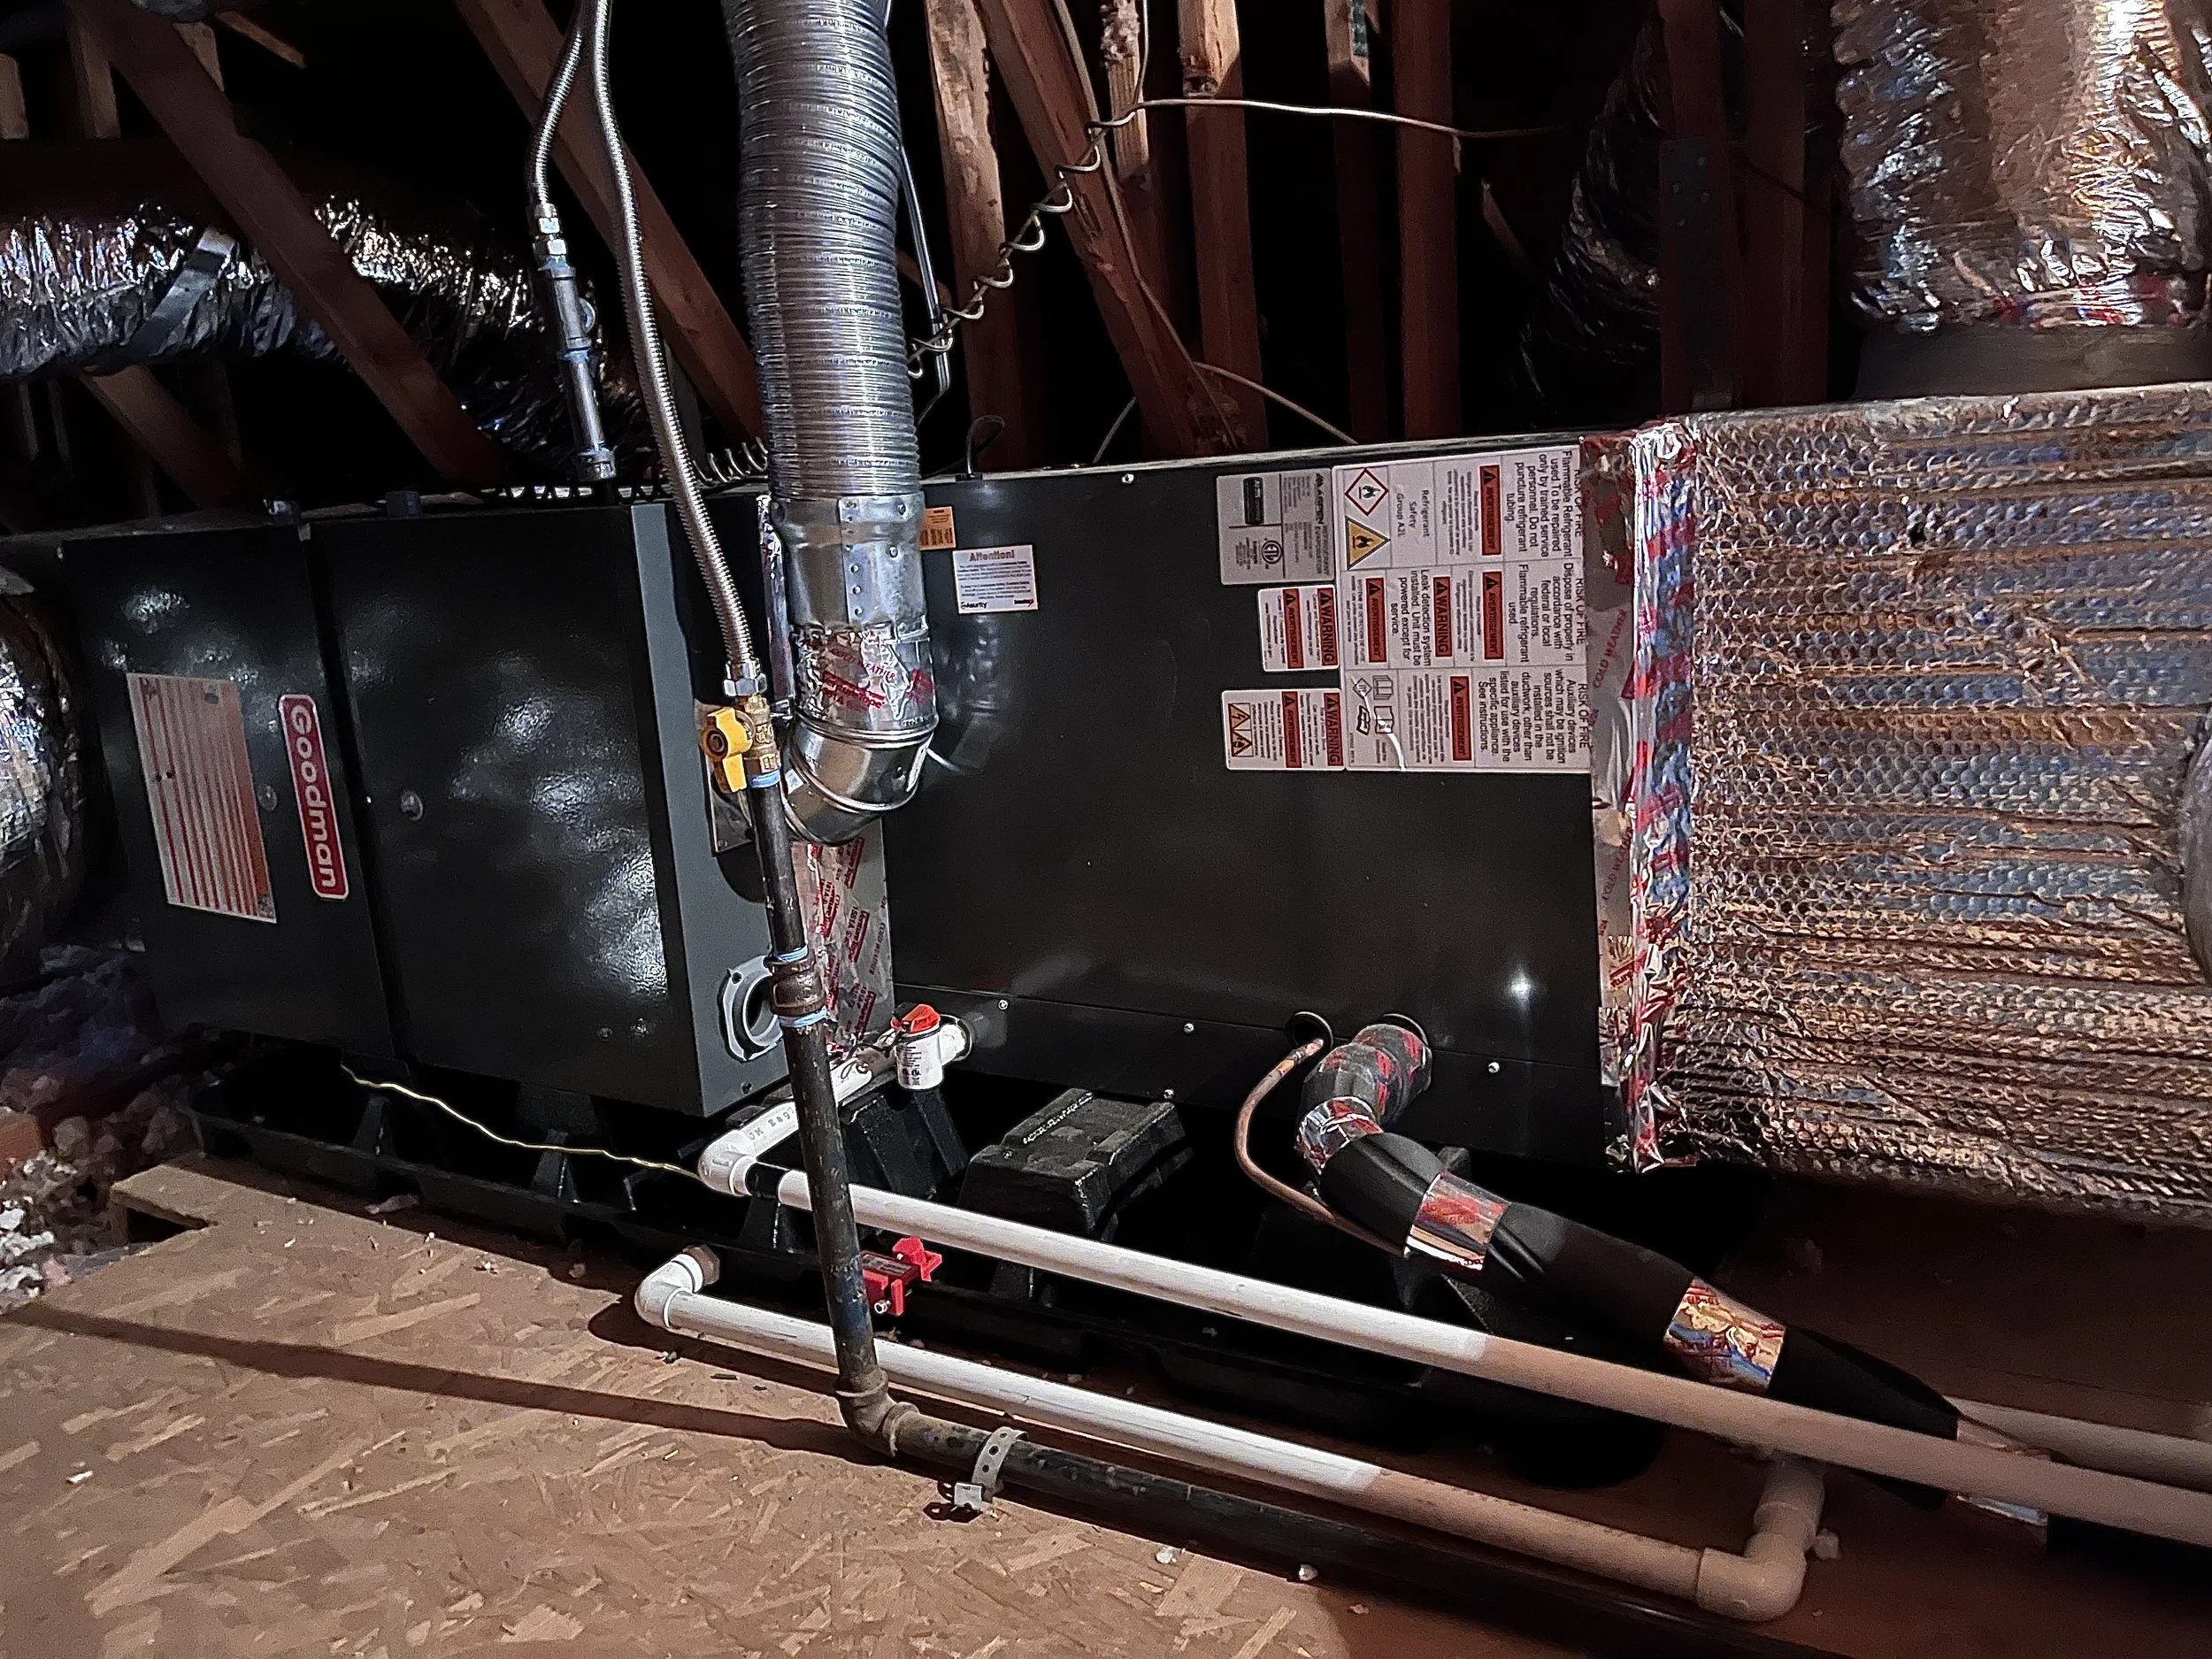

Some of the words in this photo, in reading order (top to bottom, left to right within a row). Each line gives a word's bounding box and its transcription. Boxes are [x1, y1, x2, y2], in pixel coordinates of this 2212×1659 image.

[1537, 454, 1548, 472] only
[1563, 450, 1571, 502] Flammable
[1515, 462, 1526, 502] puncture
[1539, 476, 1548, 488] by
[1552, 485, 1561, 496] To
[1396, 493, 1405, 520] Group
[1421, 489, 1430, 538] Refrigerant
[1540, 490, 1549, 521] trained
[1552, 499, 1561, 511] be
[1516, 505, 1527, 552] refrigerant
[1530, 517, 1539, 530] Do
[1550, 513, 1562, 551] repaired
[1561, 505, 1572, 557] Refrigerant
[1530, 533, 1539, 548] not
[970, 550, 1015, 562] Attention!
[1420, 570, 1431, 590] Leak
[1518, 565, 1529, 614] Flammable
[1563, 563, 1573, 600] Dispose
[1575, 579, 1584, 602] RISK
[1398, 577, 1409, 614] powered
[1541, 580, 1550, 611] federal
[1564, 603, 1574, 611] of
[1390, 603, 1400, 636] service.
[1421, 593, 1431, 633] detection
[1436, 595, 1448, 653] WARNING
[1488, 592, 1498, 654] AVERTISSEMENT
[1528, 588, 1540, 639] regulations.
[1542, 614, 1549, 623] or
[1576, 605, 1585, 618] OF
[1321, 606, 1335, 663] WARNING
[1371, 598, 1380, 657] AVERTISSEMENT
[1400, 617, 1409, 646] except
[1517, 617, 1529, 663] refrigerant
[1542, 626, 1551, 647] local
[1554, 631, 1563, 649] with
[1563, 613, 1574, 650] properly
[1576, 622, 1585, 645] FIRE
[1402, 648, 1411, 660] for
[1413, 655, 1420, 665] be
[1420, 635, 1431, 666] system
[1500, 671, 1509, 694] listed
[1555, 669, 1564, 695] which
[1593, 658, 1609, 688] COLD
[1479, 681, 1487, 698] See
[1487, 678, 1499, 710] specific
[1510, 680, 1520, 719] auxiliary
[1522, 672, 1531, 714] ductwork,
[1533, 685, 1542, 721] installed
[1565, 680, 1576, 718] Auxiliary
[1578, 684, 1588, 706] RISK
[1545, 710, 1555, 730] shall
[1555, 697, 1563, 717] may
[1578, 710, 1588, 723] OF
[1327, 710, 1340, 763] WARNING
[1489, 712, 1500, 756] appliance.
[1512, 719, 1521, 752] devices
[1556, 719, 1564, 730] be
[1567, 719, 1577, 753] devices
[1579, 726, 1589, 749] FIRE
[1524, 742, 1532, 761] than
[1546, 733, 1555, 747] not
[1546, 749, 1555, 760] be
[1555, 733, 1566, 764] ignition
[1502, 749, 1511, 762] the
[291, 704, 336, 888] Goodman
[854, 910, 867, 942] Venture
[848, 941, 859, 963] Tape
[747, 1126, 764, 1141] JM
